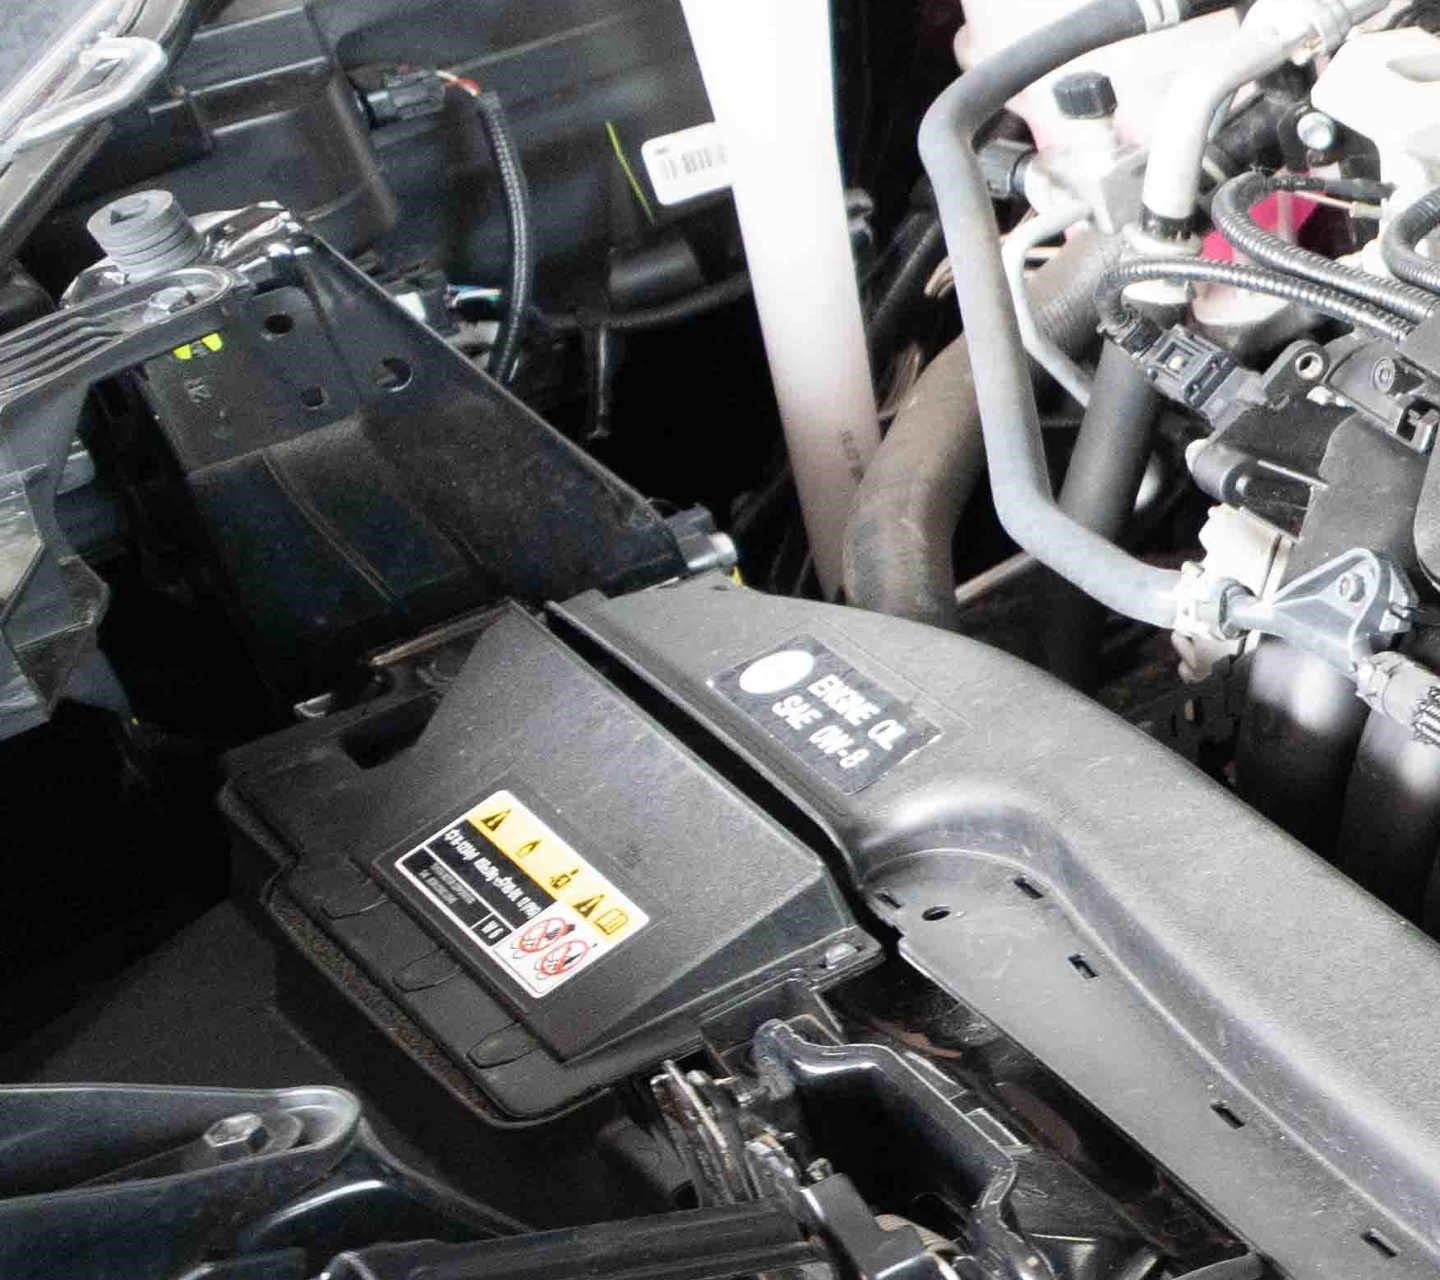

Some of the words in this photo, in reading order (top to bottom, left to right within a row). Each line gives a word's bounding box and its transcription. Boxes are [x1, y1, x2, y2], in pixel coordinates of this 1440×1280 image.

[771, 695, 822, 732] SAE
[808, 724, 868, 769] 0W-8
[807, 674, 881, 725] ENGINE
[866, 716, 907, 753] OIL
